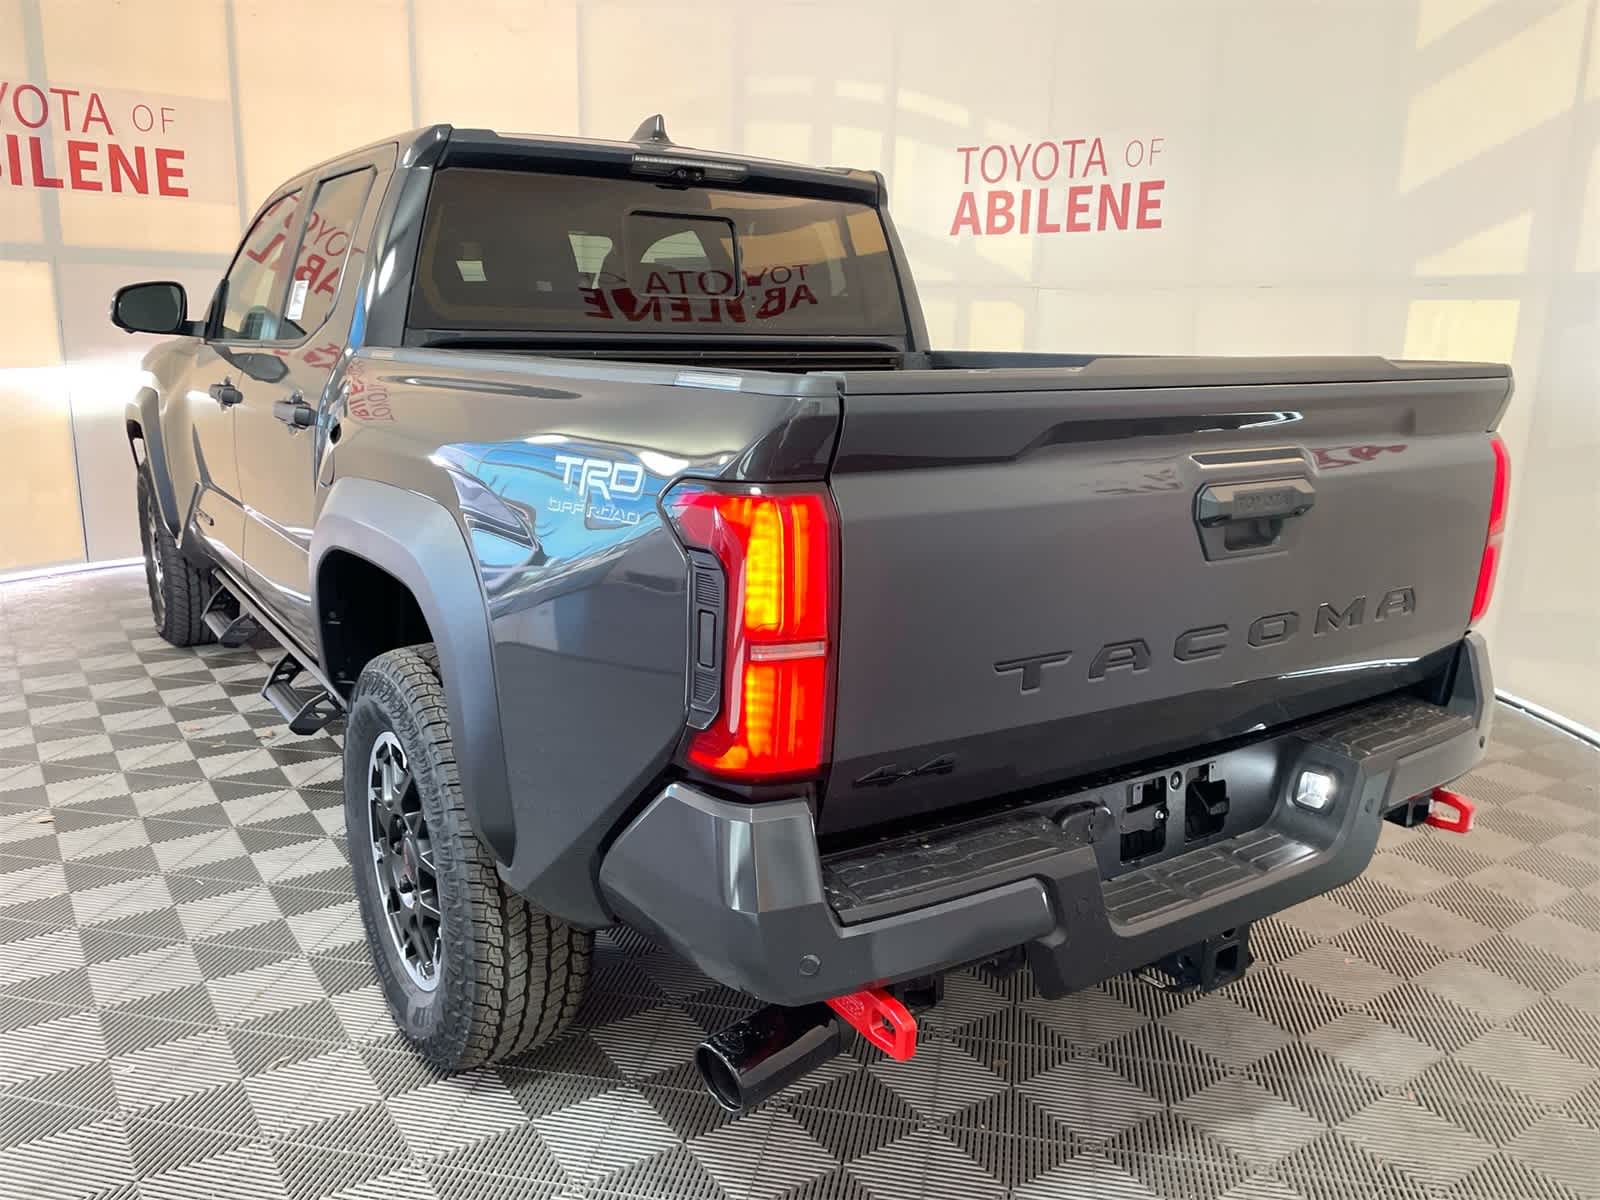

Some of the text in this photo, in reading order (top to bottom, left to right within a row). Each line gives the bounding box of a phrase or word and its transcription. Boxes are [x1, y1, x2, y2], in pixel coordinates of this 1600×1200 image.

[0, 82, 175, 135] OTA OF
[0, 134, 189, 197] ILENE
[957, 137, 1165, 184] TOYOTA OF
[950, 180, 1166, 236] ABILENE
[554, 455, 645, 500] TRD
[993, 585, 1417, 696] TACOMA
